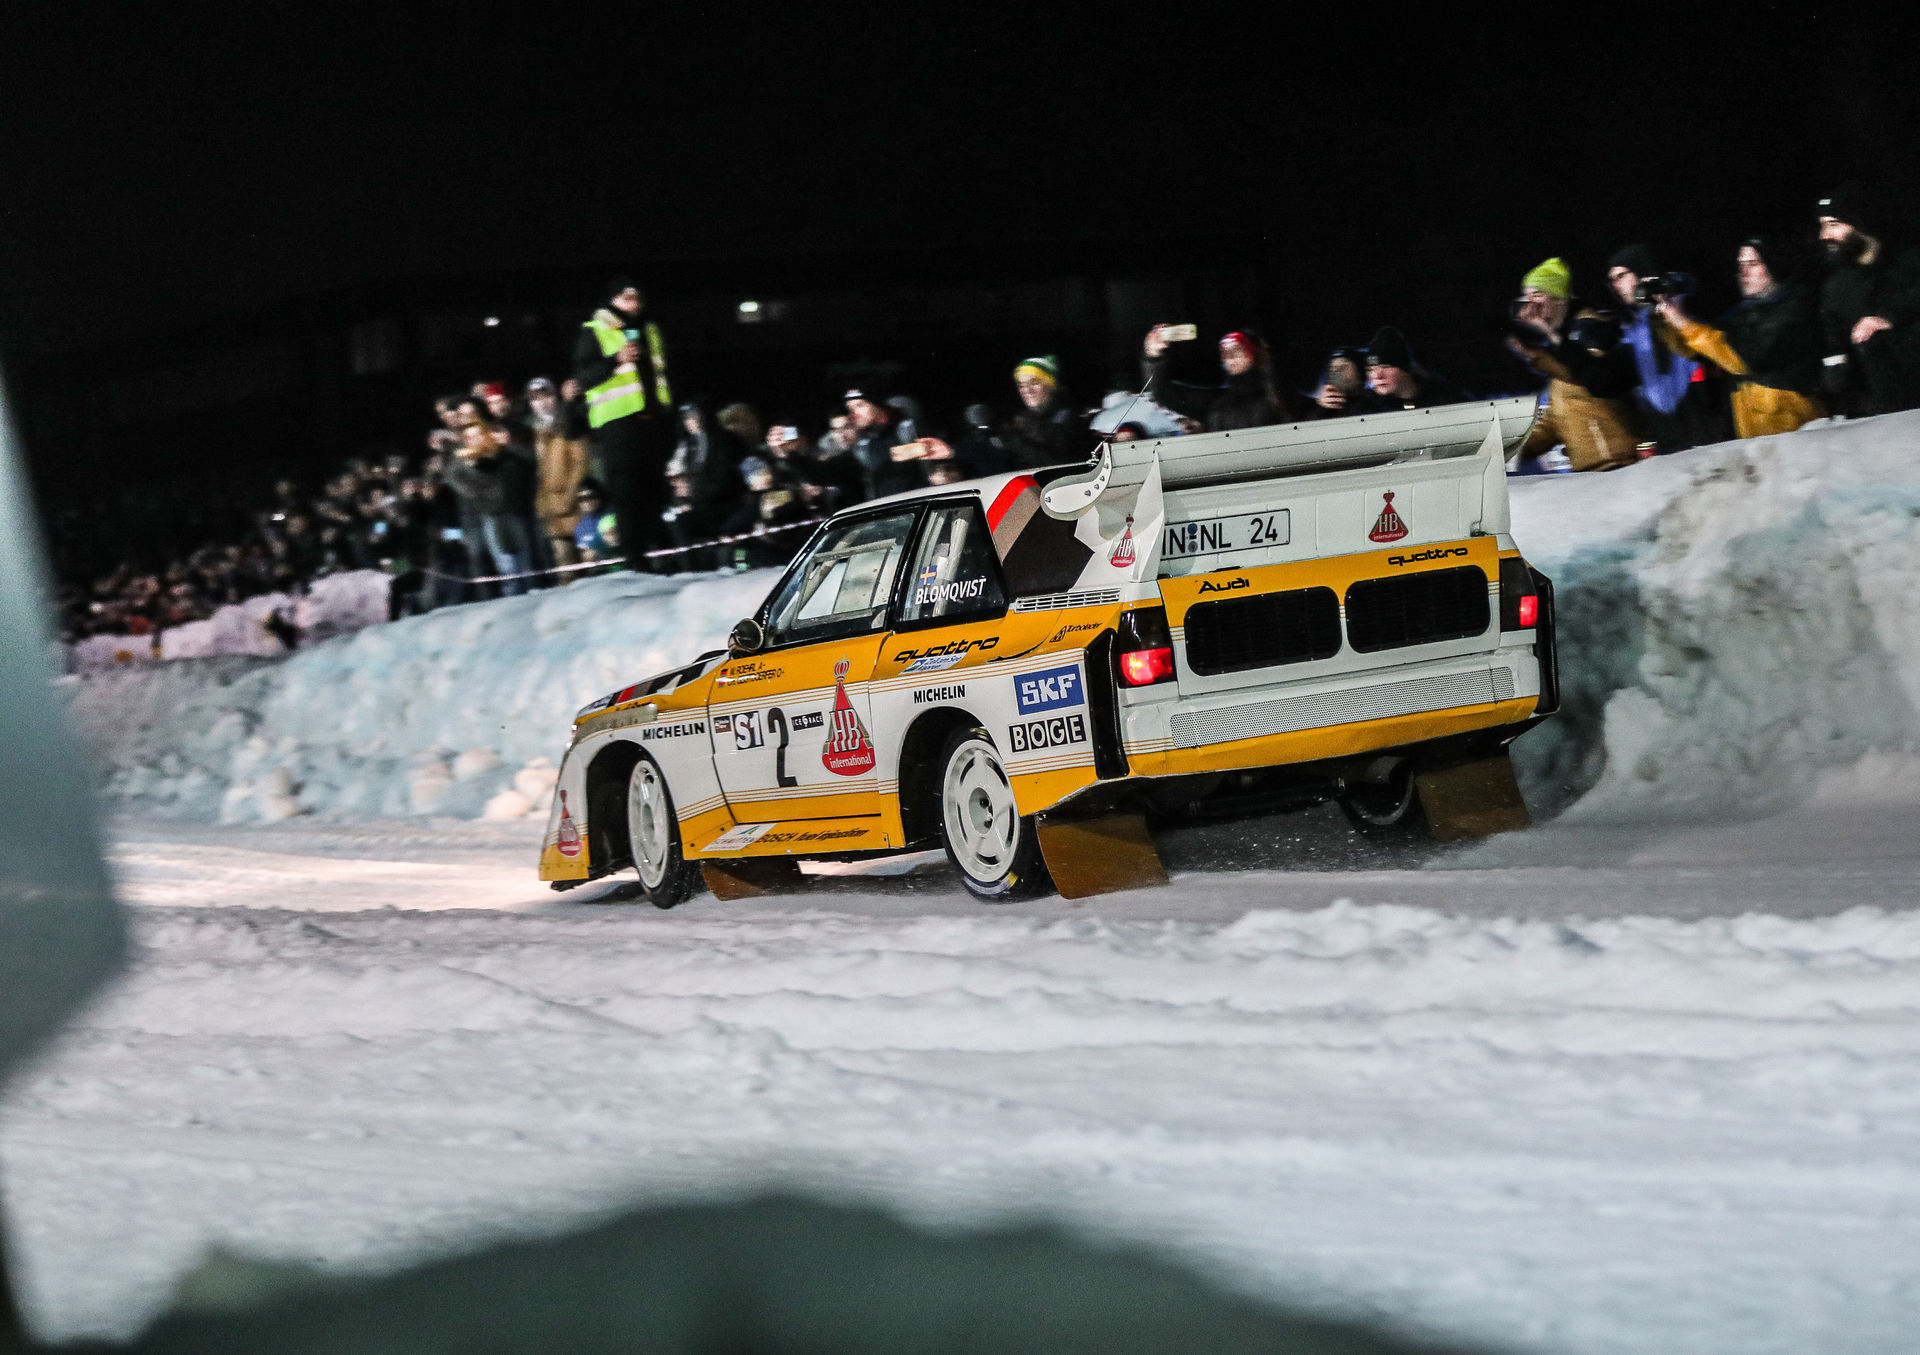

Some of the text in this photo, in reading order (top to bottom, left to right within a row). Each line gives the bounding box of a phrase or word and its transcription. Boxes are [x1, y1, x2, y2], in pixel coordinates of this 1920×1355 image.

[1250, 517, 1278, 543] 24
[1378, 512, 1399, 533] HB
[1387, 546, 1468, 567] quattro
[915, 578, 987, 605] BLOMQVIST
[1199, 578, 1250, 595] Audi
[894, 636, 1000, 664] quattro
[913, 685, 966, 704] MICHELIN
[1021, 673, 1077, 706] SKF
[642, 722, 706, 741] MICHELIN
[735, 712, 762, 749] S1
[829, 707, 861, 754] HB
[1011, 715, 1084, 751] BOGE
[767, 707, 799, 788] 2
[829, 752, 873, 769] international
